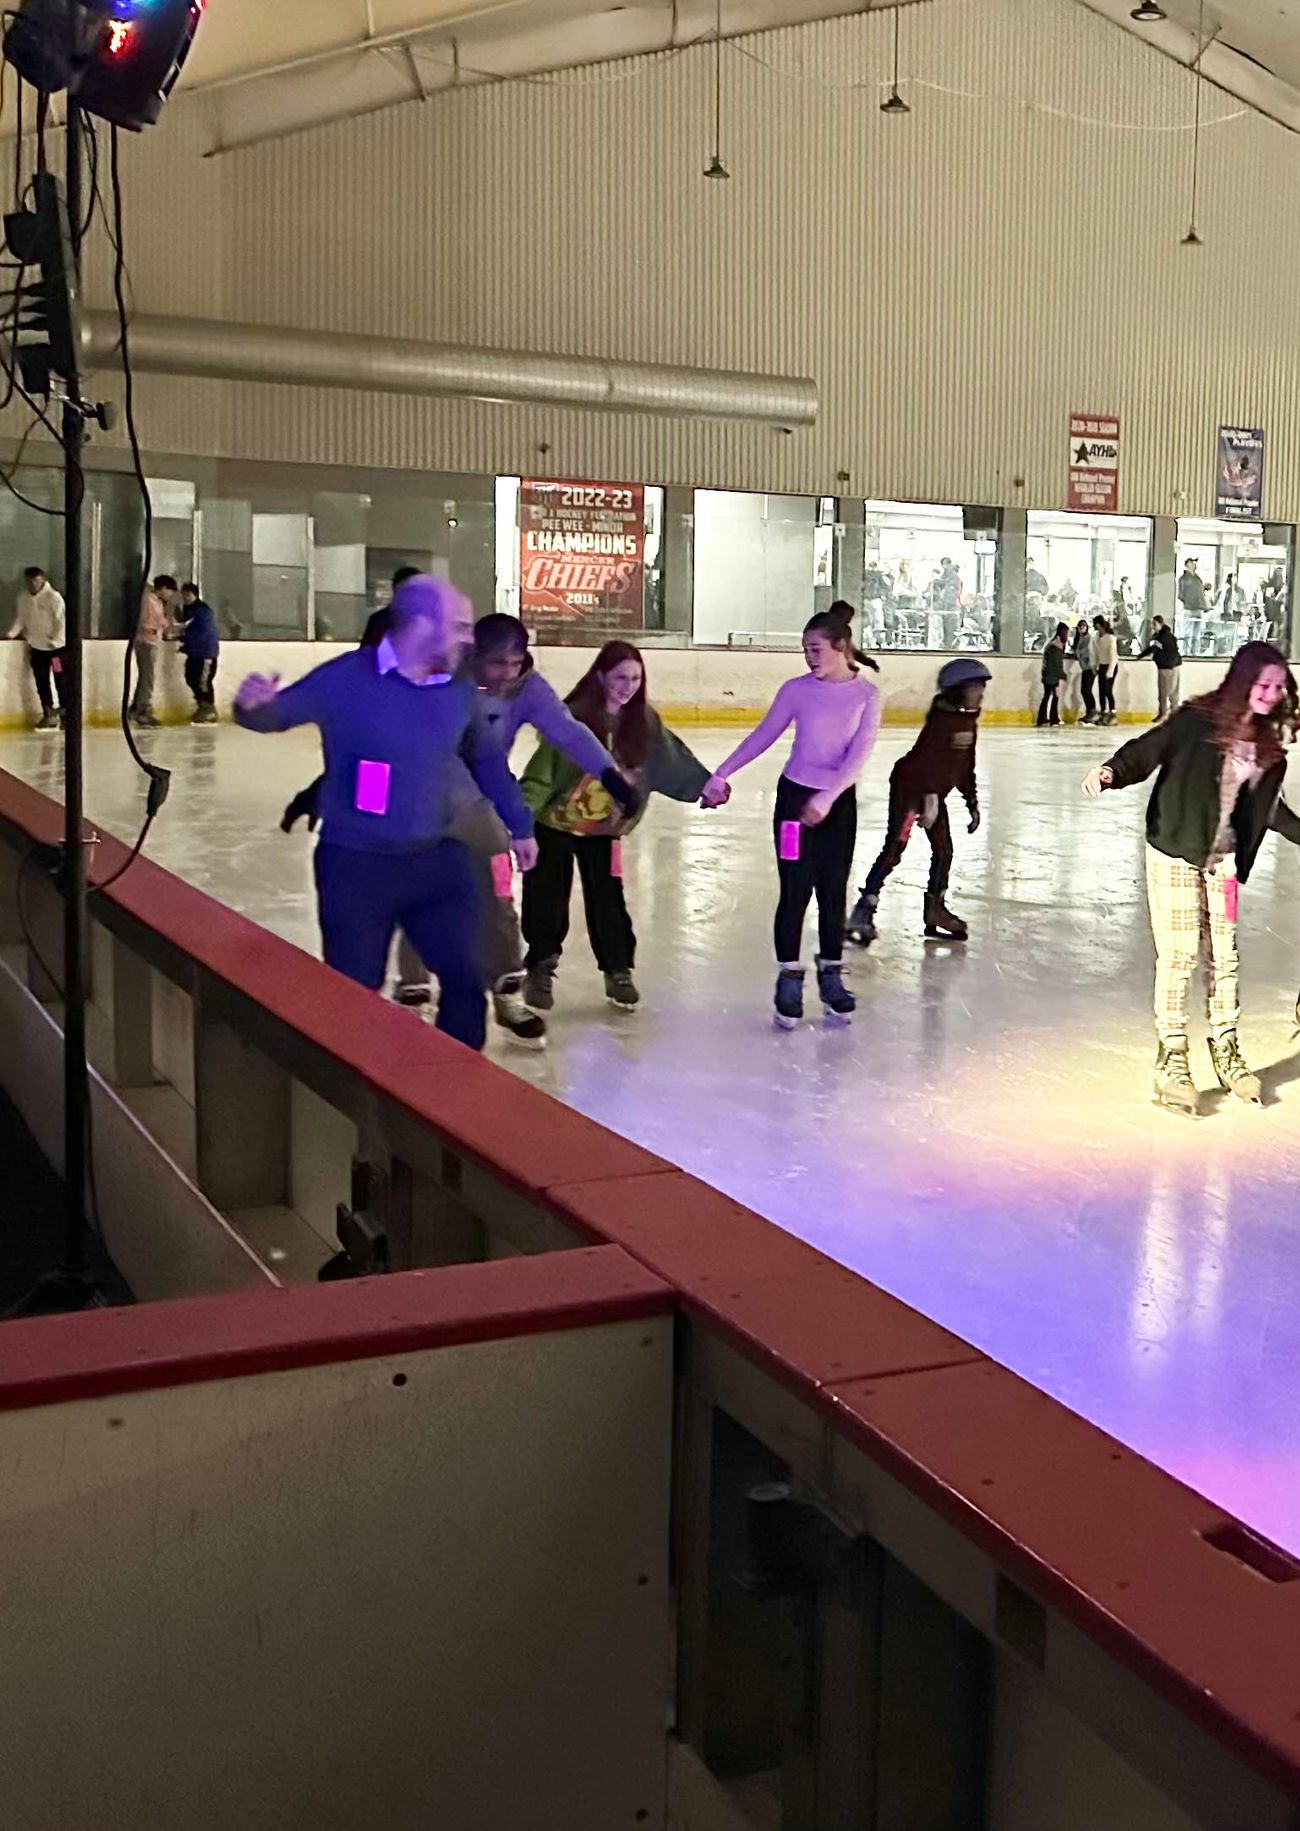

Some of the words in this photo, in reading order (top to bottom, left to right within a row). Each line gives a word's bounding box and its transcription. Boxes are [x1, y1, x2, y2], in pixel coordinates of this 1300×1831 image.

[561, 486, 633, 509] 2022-23
[542, 519, 562, 531] PEE
[562, 519, 585, 531] WEE
[591, 522, 624, 533] MINOR
[527, 530, 637, 555] CHAMPIONS
[525, 558, 639, 593] CHIEFS
